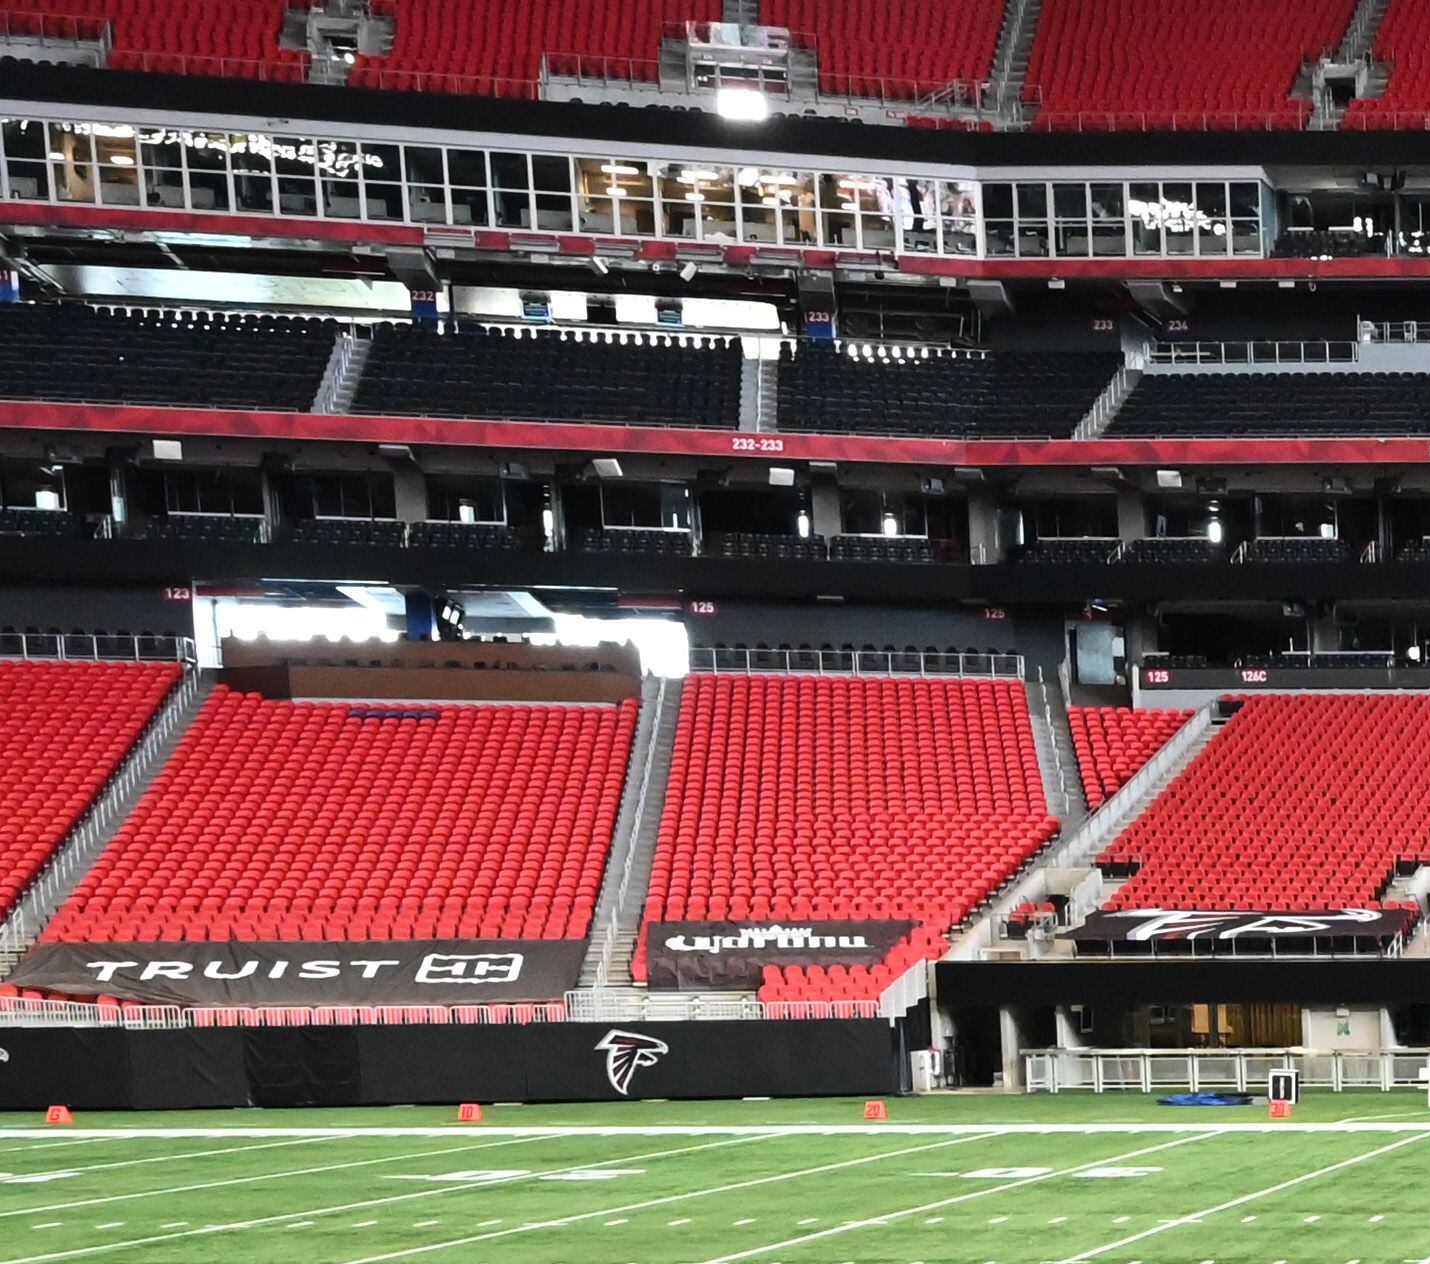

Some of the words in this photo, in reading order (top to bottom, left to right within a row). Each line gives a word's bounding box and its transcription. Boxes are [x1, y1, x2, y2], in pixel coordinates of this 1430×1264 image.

[413, 291, 434, 301] 232
[809, 312, 828, 322] 233
[1094, 320, 1113, 330] 233
[1169, 320, 1188, 330] 234
[732, 438, 783, 451] 232-233
[166, 588, 190, 599] 123
[692, 602, 714, 613] 125
[985, 608, 1005, 619] 125
[1147, 671, 1169, 682] 125
[1242, 671, 1267, 682] 126C
[87, 960, 401, 981] TRUIST
[463, 1106, 473, 1118] 10
[867, 1103, 880, 1117] 20
